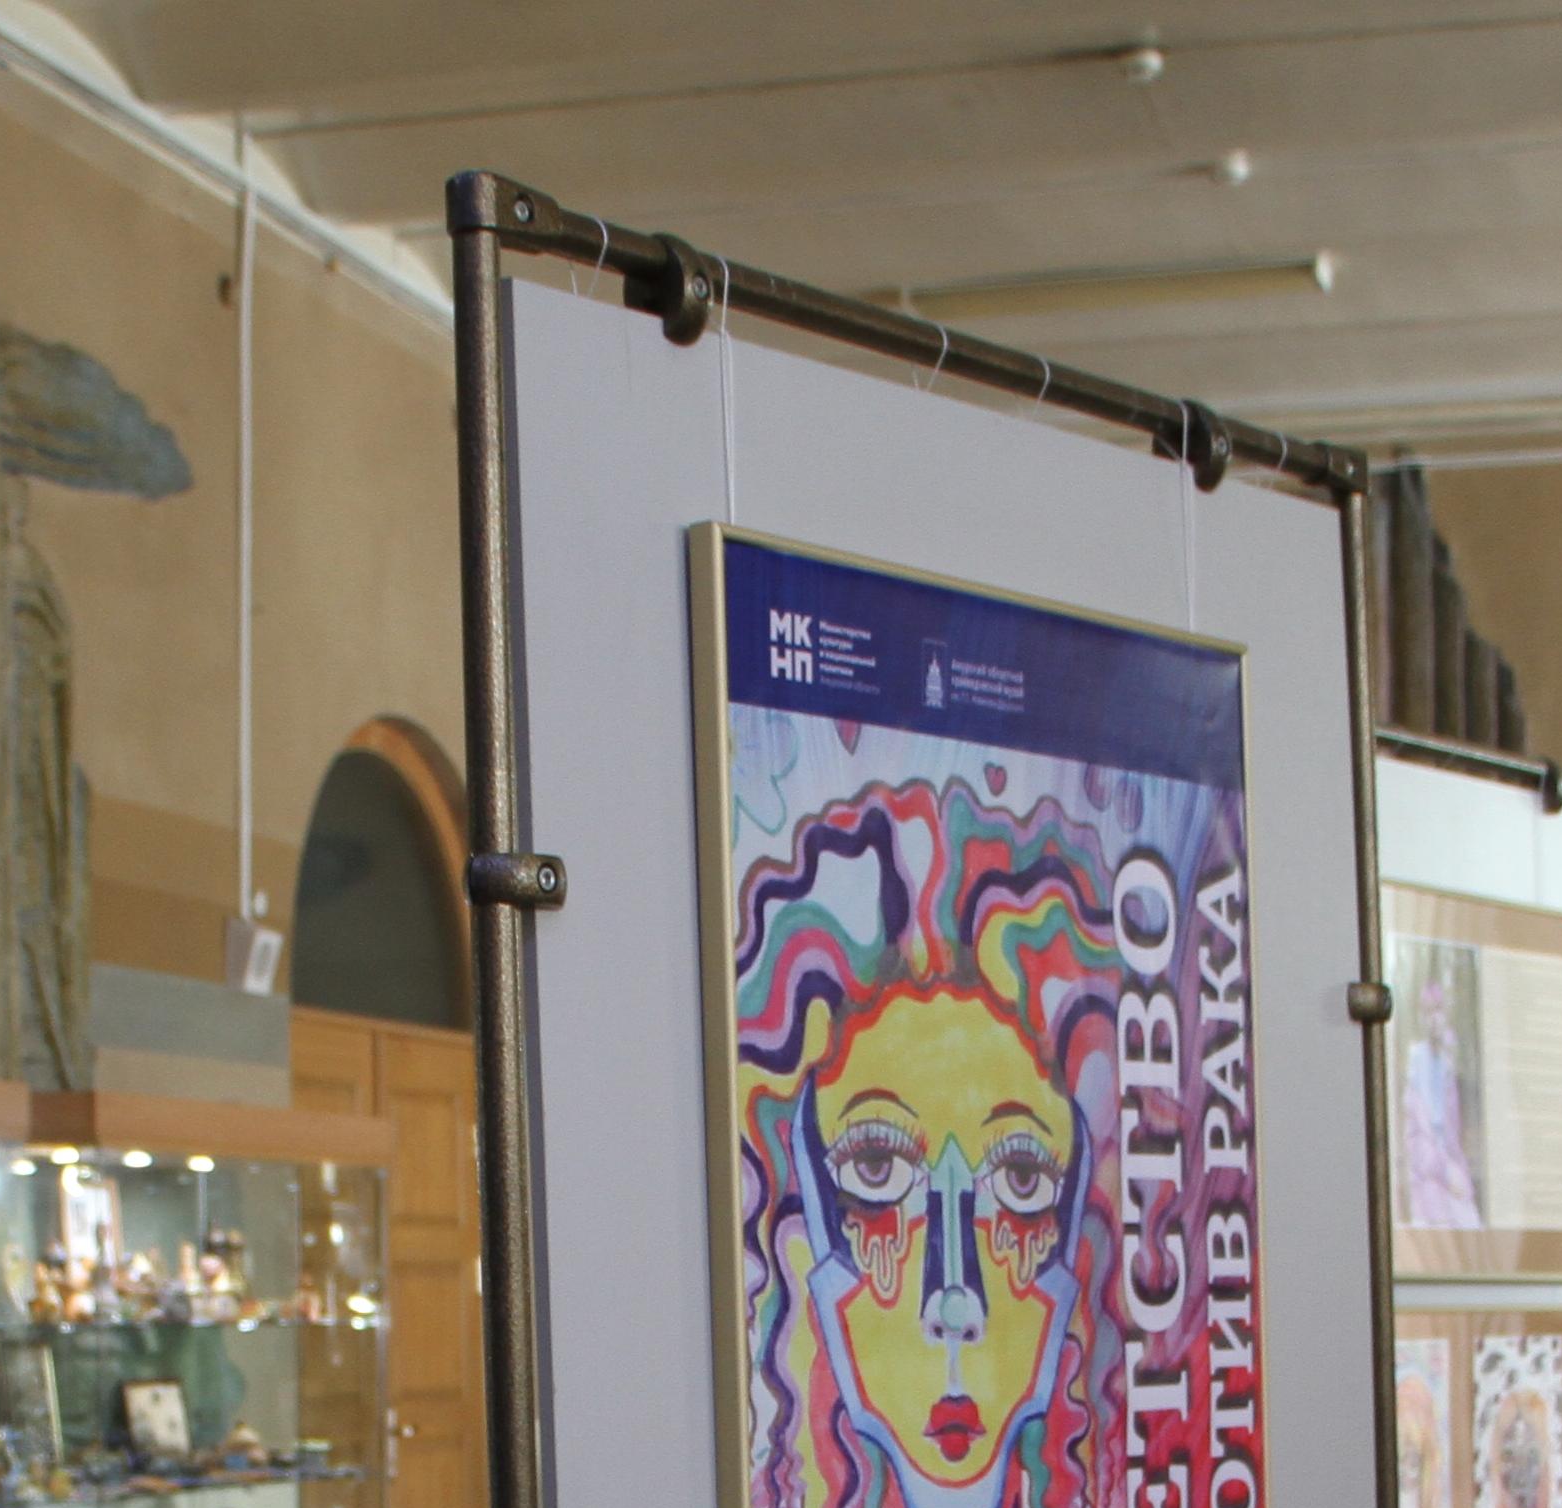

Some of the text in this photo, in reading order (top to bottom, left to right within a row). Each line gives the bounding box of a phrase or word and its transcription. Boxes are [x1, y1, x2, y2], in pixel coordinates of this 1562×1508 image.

[769, 608, 813, 649] МК
[769, 644, 814, 685] НП
[1196, 864, 1247, 1174] РАКА
